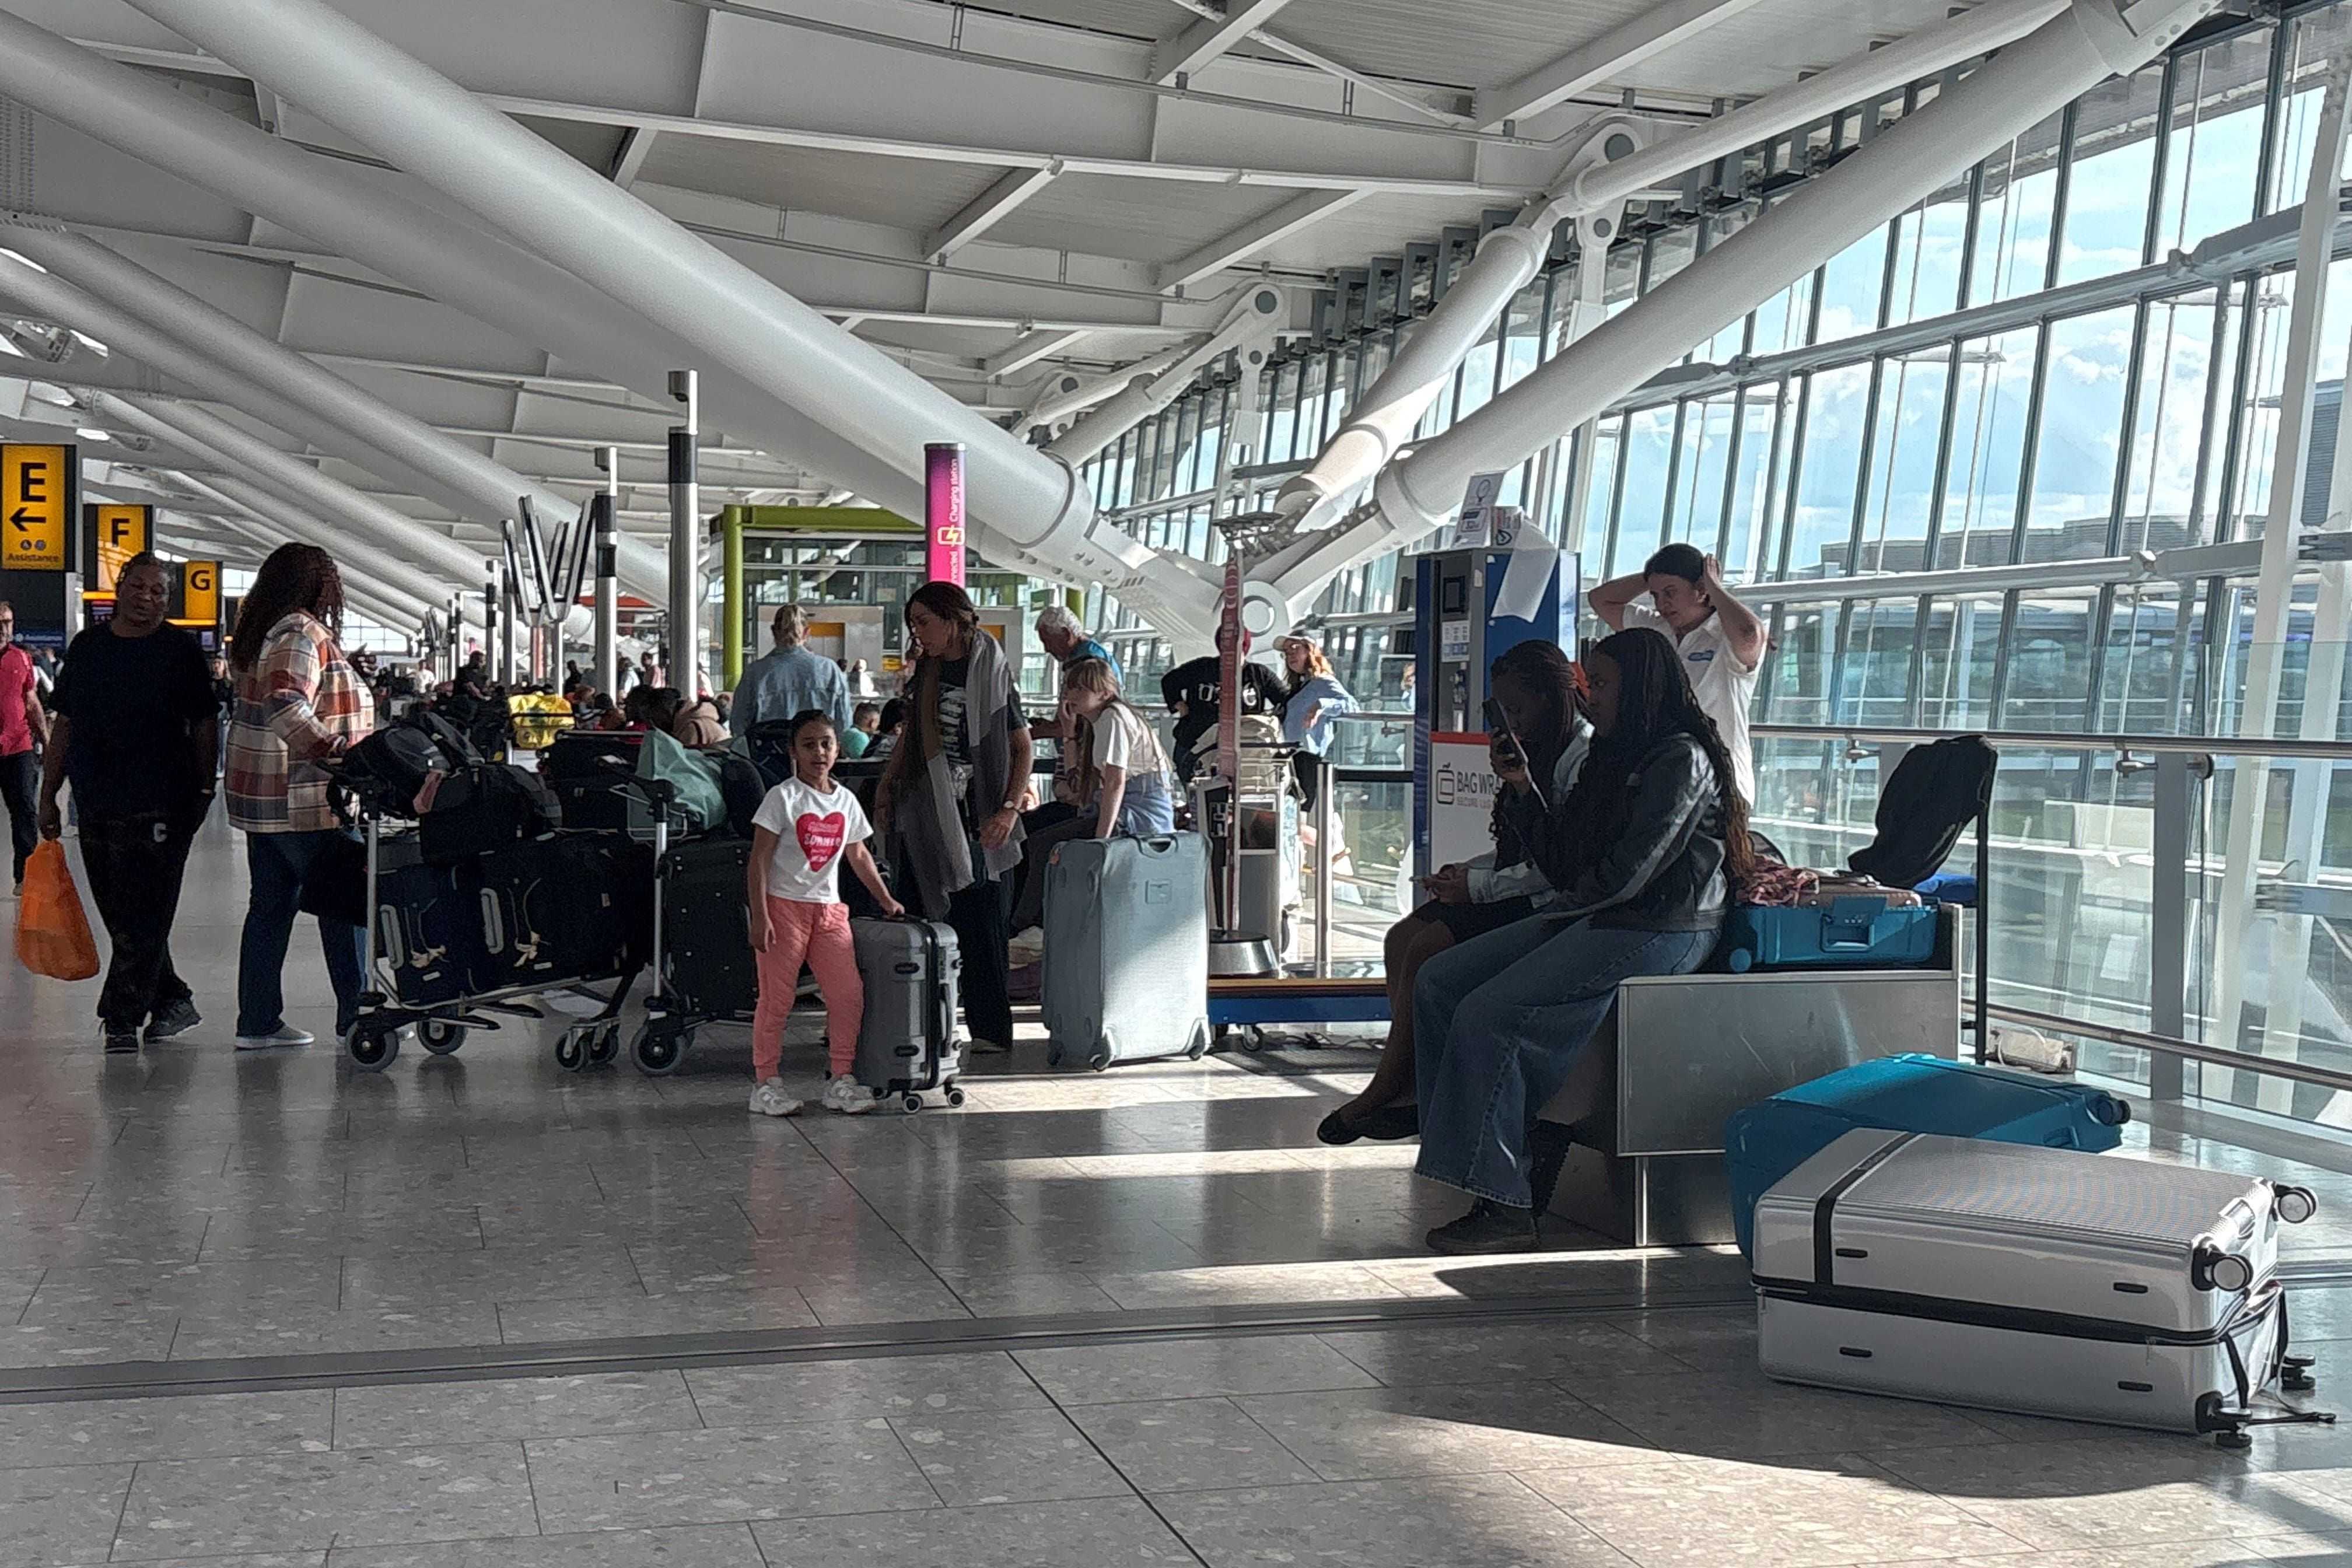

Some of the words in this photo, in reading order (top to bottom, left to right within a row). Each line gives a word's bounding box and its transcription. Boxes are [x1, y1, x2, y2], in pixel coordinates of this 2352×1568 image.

[20, 462, 47, 502] E
[950, 458, 958, 485] station
[949, 485, 960, 522] Charging
[111, 518, 130, 547] F
[190, 569, 211, 592] G
[949, 551, 958, 583] nnected
[1457, 771, 1478, 794] BAG
